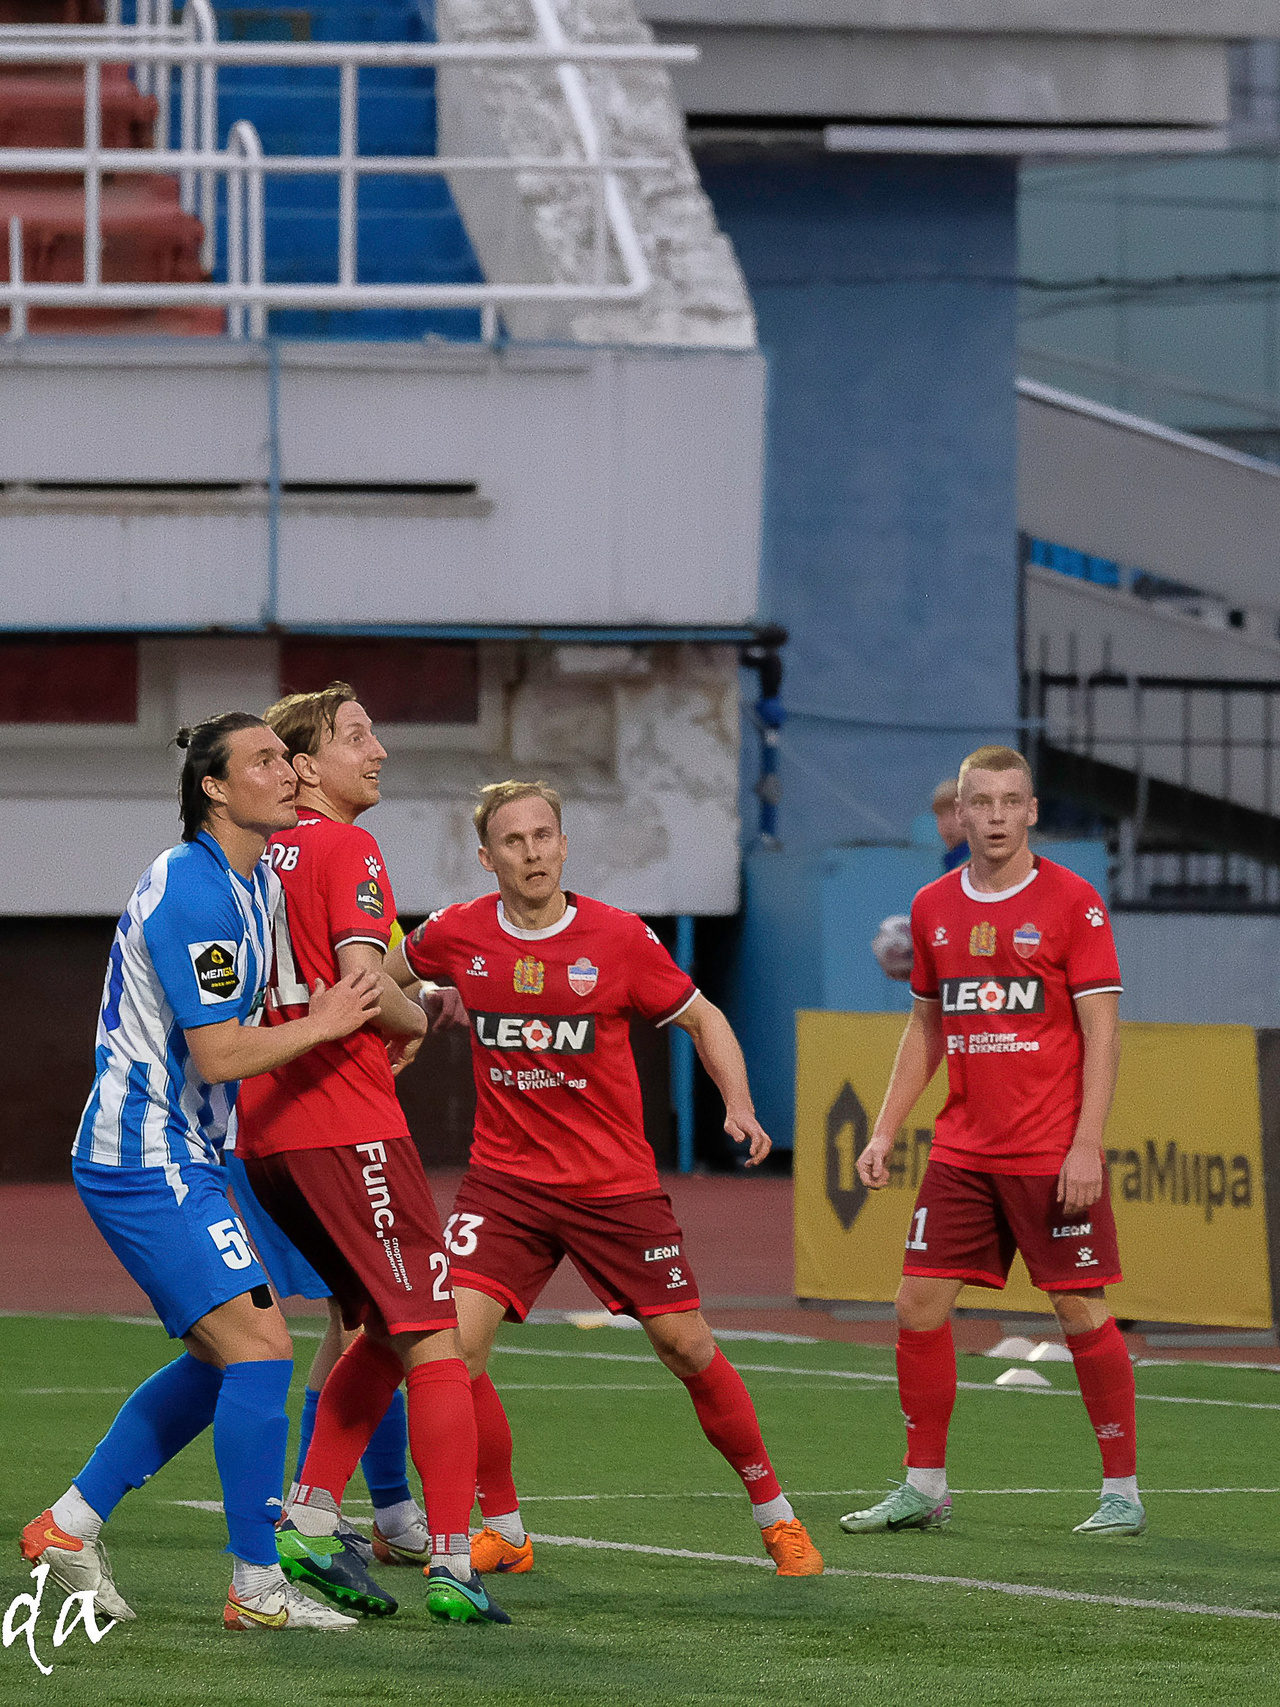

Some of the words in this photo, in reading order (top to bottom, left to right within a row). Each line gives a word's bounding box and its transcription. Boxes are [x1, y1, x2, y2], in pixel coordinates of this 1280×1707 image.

[942, 981, 1039, 1012] LEON
[476, 1016, 589, 1051] LEON
[356, 1141, 396, 1239] Func.
[1052, 1223, 1092, 1238] LEON
[392, 1237, 413, 1291] спортивный
[644, 1244, 680, 1262] LEON
